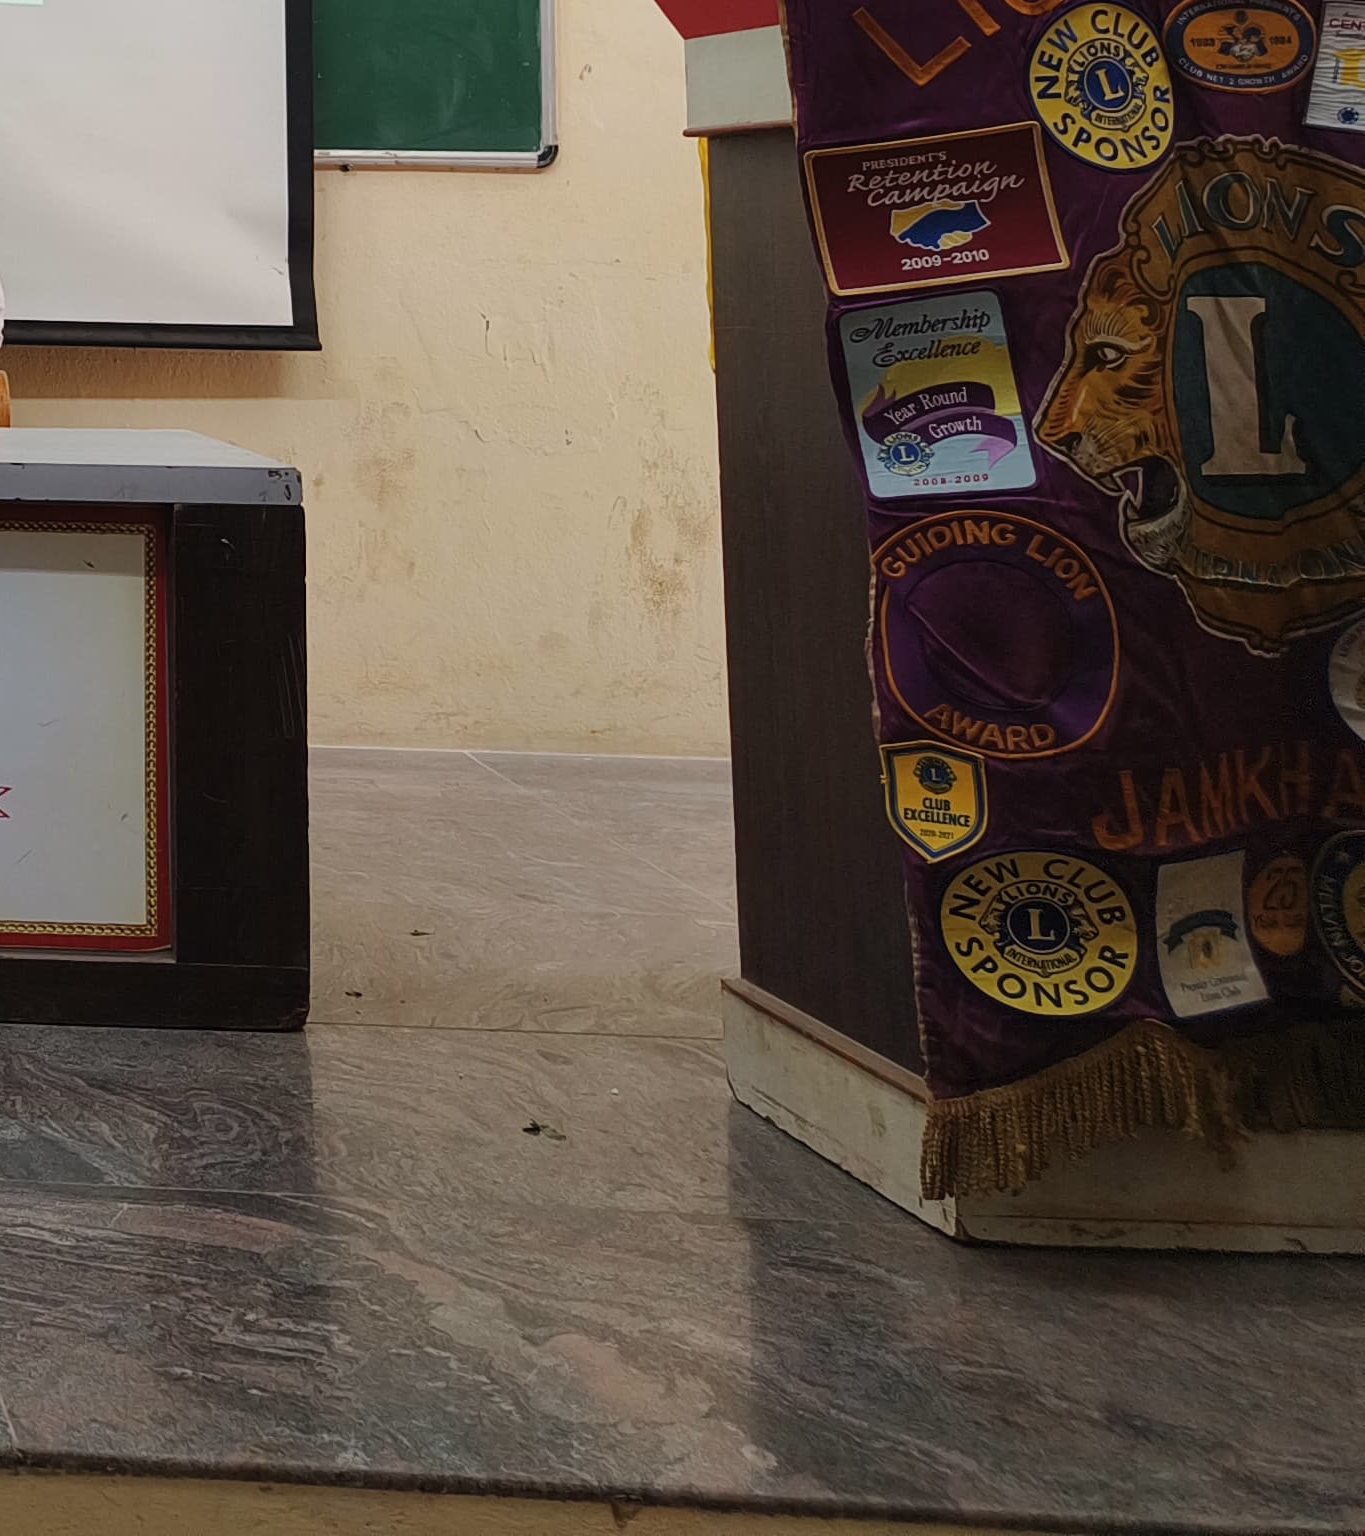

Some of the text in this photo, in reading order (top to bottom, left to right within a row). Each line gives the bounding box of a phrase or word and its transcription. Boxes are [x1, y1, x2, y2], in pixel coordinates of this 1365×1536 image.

[1035, 9, 1160, 100] NEW CLUB
[1073, 41, 1120, 68] LIONS
[1095, 67, 1126, 102] L
[1052, 84, 1171, 163] SPONSOR
[846, 159, 998, 193] Retention
[866, 172, 1025, 209] Campaign
[900, 247, 990, 271] 2009-2010
[849, 308, 991, 343] Membership
[872, 339, 982, 368] Excellence
[1186, 296, 1307, 477] L
[928, 415, 982, 440] Growth
[880, 517, 1102, 602] GUIDING LION
[923, 701, 1057, 751] AWARD
[903, 807, 971, 828] EXCELLENCE
[922, 797, 951, 812] CLUB
[948, 858, 1126, 925] NEW CLUB
[1003, 883, 1071, 904] LIONS
[1027, 907, 1057, 942] L
[955, 936, 1129, 1008] SPONSOR
